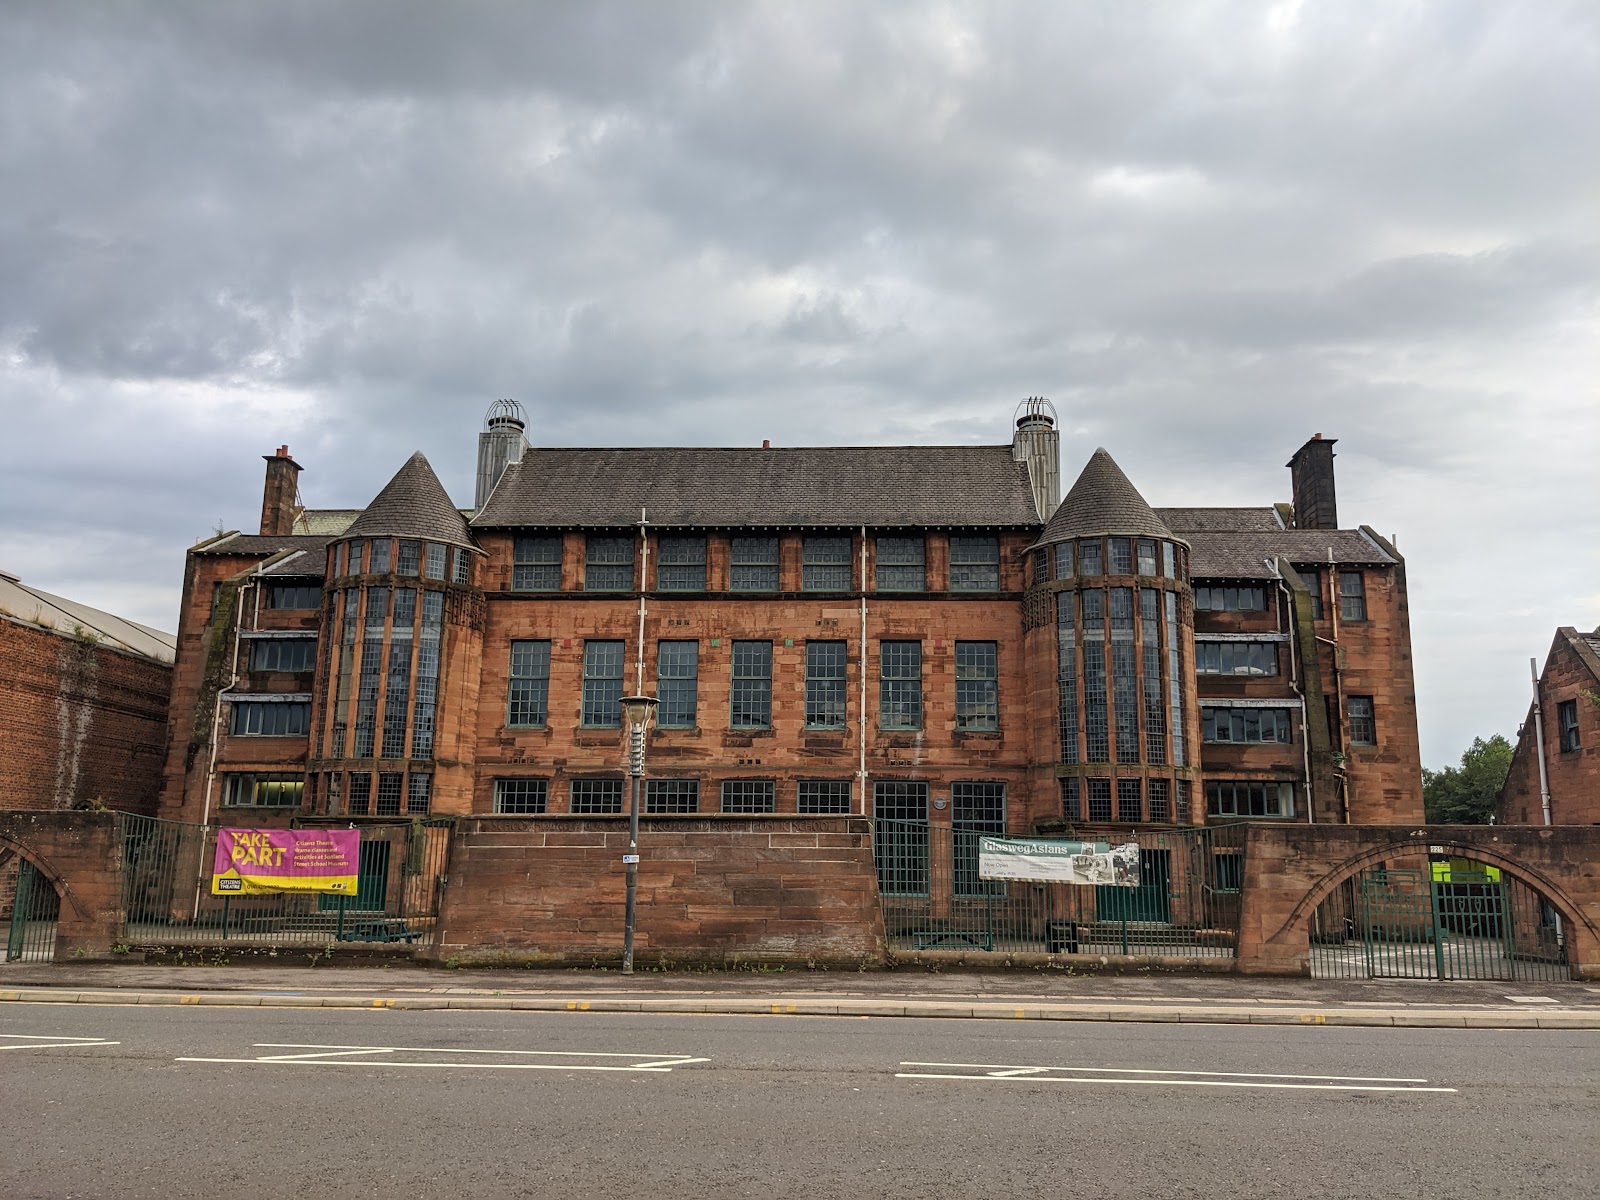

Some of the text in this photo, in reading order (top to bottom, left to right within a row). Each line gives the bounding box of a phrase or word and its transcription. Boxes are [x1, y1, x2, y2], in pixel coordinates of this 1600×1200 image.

[231, 832, 270, 847] TAKE
[984, 841, 1068, 854] GlaswegAsians
[232, 847, 287, 866] PART
